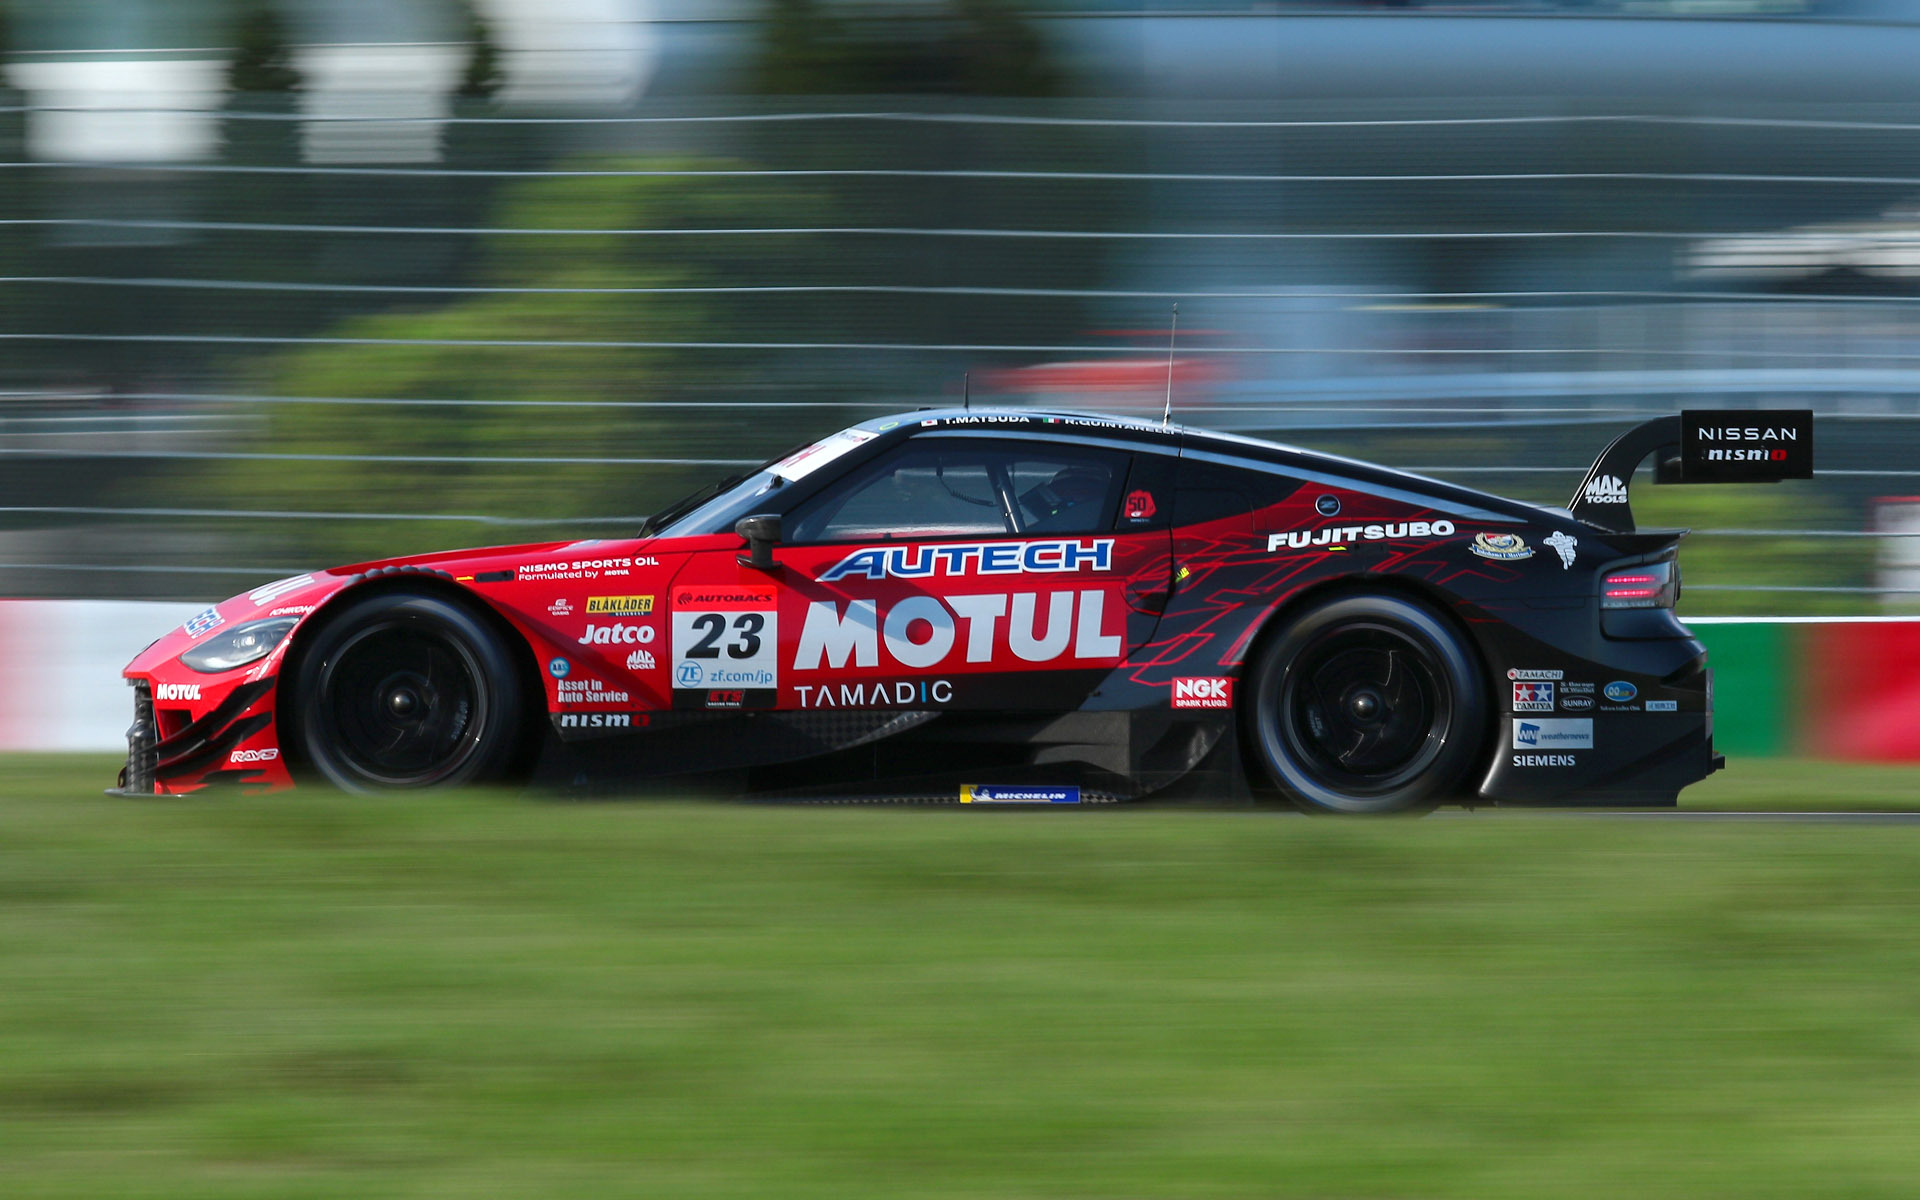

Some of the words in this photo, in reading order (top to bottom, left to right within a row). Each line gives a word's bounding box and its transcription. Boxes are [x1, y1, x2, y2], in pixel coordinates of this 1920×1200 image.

[943, 415, 1030, 425] T.MATSUDA
[1698, 427, 1797, 441] NISSAN
[1585, 474, 1627, 496] MAC
[1128, 497, 1146, 511] 50
[1585, 495, 1628, 504] TOOLS
[1267, 520, 1455, 553] FUJITSUBO
[519, 562, 569, 573] NISMO
[571, 558, 631, 570] SPORTS
[634, 556, 659, 567] OIL
[815, 538, 1115, 582] AUTECH
[518, 570, 582, 581] Formulated
[584, 570, 598, 580] by
[589, 597, 652, 611] BLÅKLÄDER
[694, 594, 772, 602] AUTOBACS
[578, 622, 655, 645] Jatco
[685, 613, 765, 660] 23
[793, 590, 1122, 670] MOTUL
[626, 649, 656, 664] MAC
[678, 665, 702, 683] ZF
[710, 669, 773, 684] zf.com/jp
[1519, 670, 1562, 679] TAMACHI
[157, 684, 201, 700] MOTUL
[558, 679, 589, 691] Asset
[1176, 679, 1228, 698] NGK
[558, 691, 583, 703] Auto
[586, 691, 629, 703] Service
[793, 680, 953, 708] TAMADIC
[1176, 698, 1200, 707] SPARK
[1202, 698, 1228, 707] PLUGS
[1514, 702, 1553, 710] TAMIYA
[1562, 699, 1592, 708] SUNRAY
[561, 714, 650, 728] nismo
[1541, 733, 1590, 741] weathernews
[230, 748, 279, 763] RAYS
[1513, 755, 1576, 767] SIEMENS
[994, 792, 1067, 800] MICHELIN
